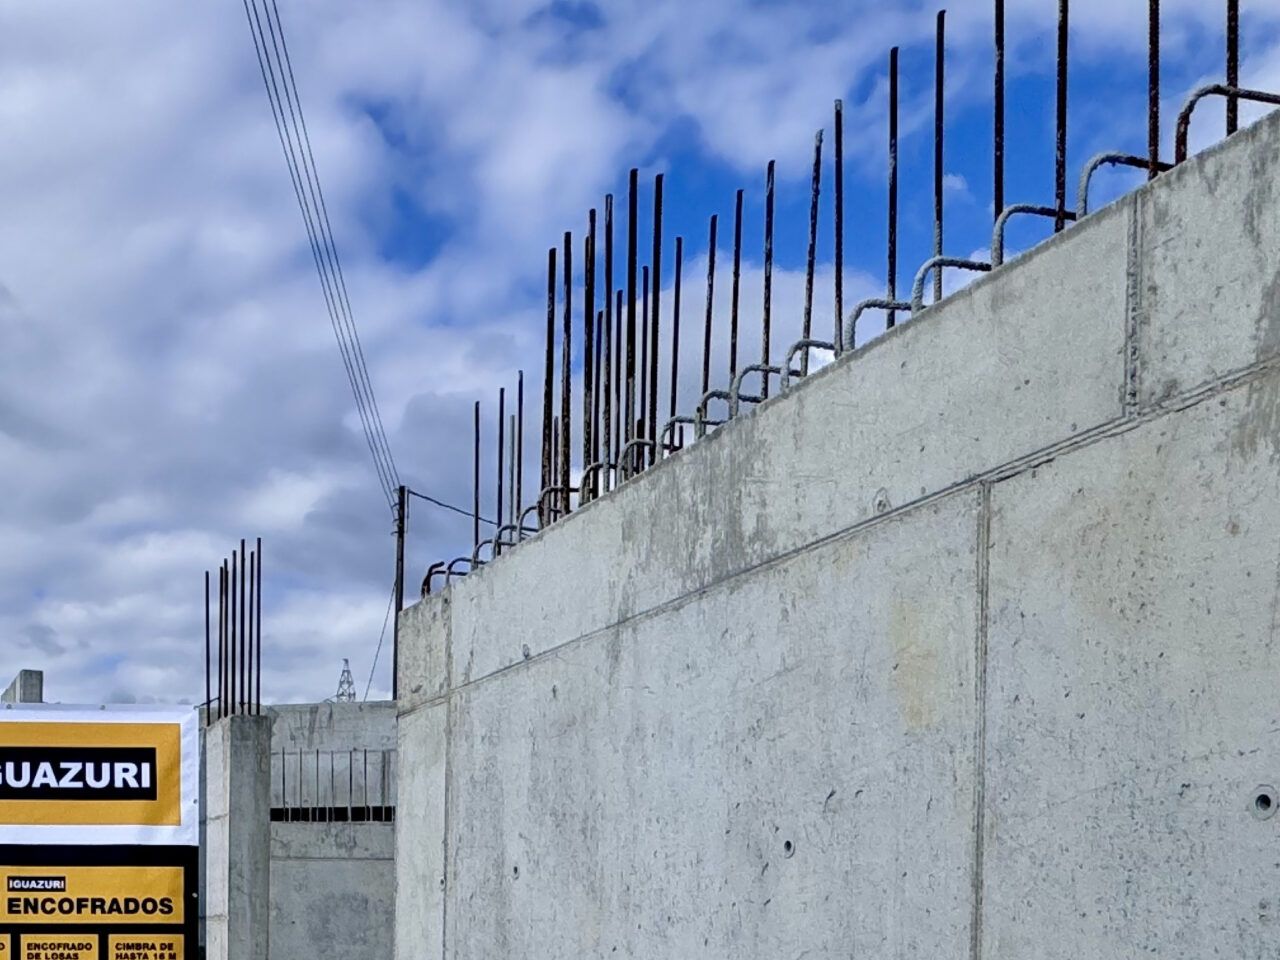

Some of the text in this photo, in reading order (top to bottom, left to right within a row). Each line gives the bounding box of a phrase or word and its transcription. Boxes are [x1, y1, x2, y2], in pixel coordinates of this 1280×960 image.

[9, 879, 65, 889] IGUAZURI
[7, 898, 173, 915] ENCOFRADOS
[26, 942, 93, 951] ENCOFRADO
[115, 943, 174, 951] CIMBRA DE
[115, 952, 149, 960] HASTA
[168, 952, 177, 960] M
